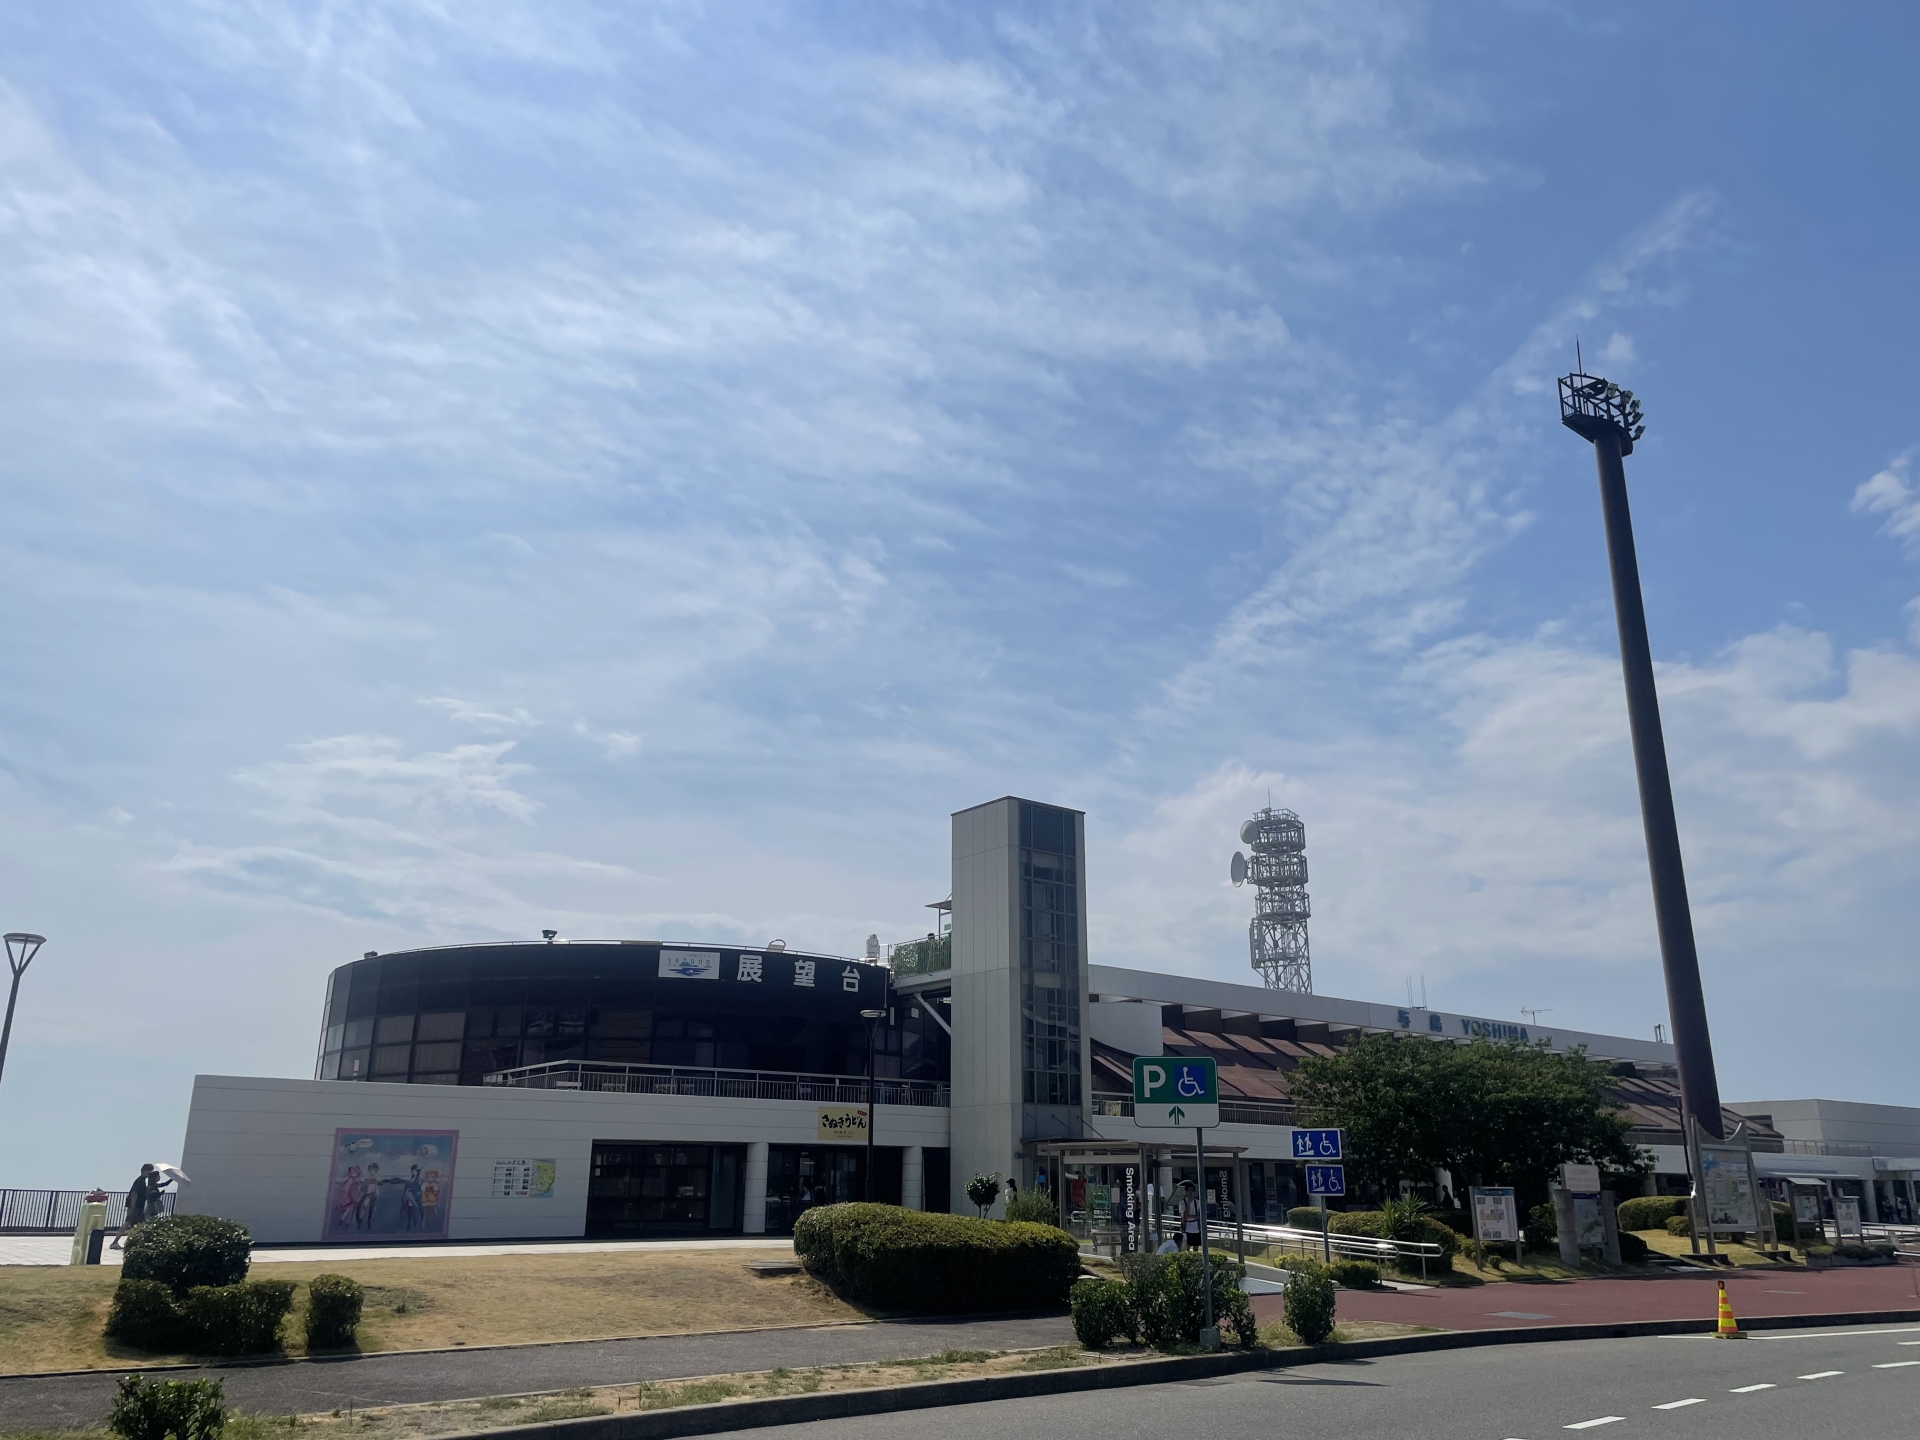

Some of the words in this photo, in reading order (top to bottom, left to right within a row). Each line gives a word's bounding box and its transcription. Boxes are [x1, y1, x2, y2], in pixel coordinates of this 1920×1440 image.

[736, 954, 861, 993] 展望台
[1460, 1018, 1530, 1042] YOSHIMA
[1142, 1065, 1166, 1098] P
[821, 1112, 867, 1129] さぬきうどん
[1125, 1167, 1135, 1219] Smoking
[1127, 1222, 1136, 1251] Area
